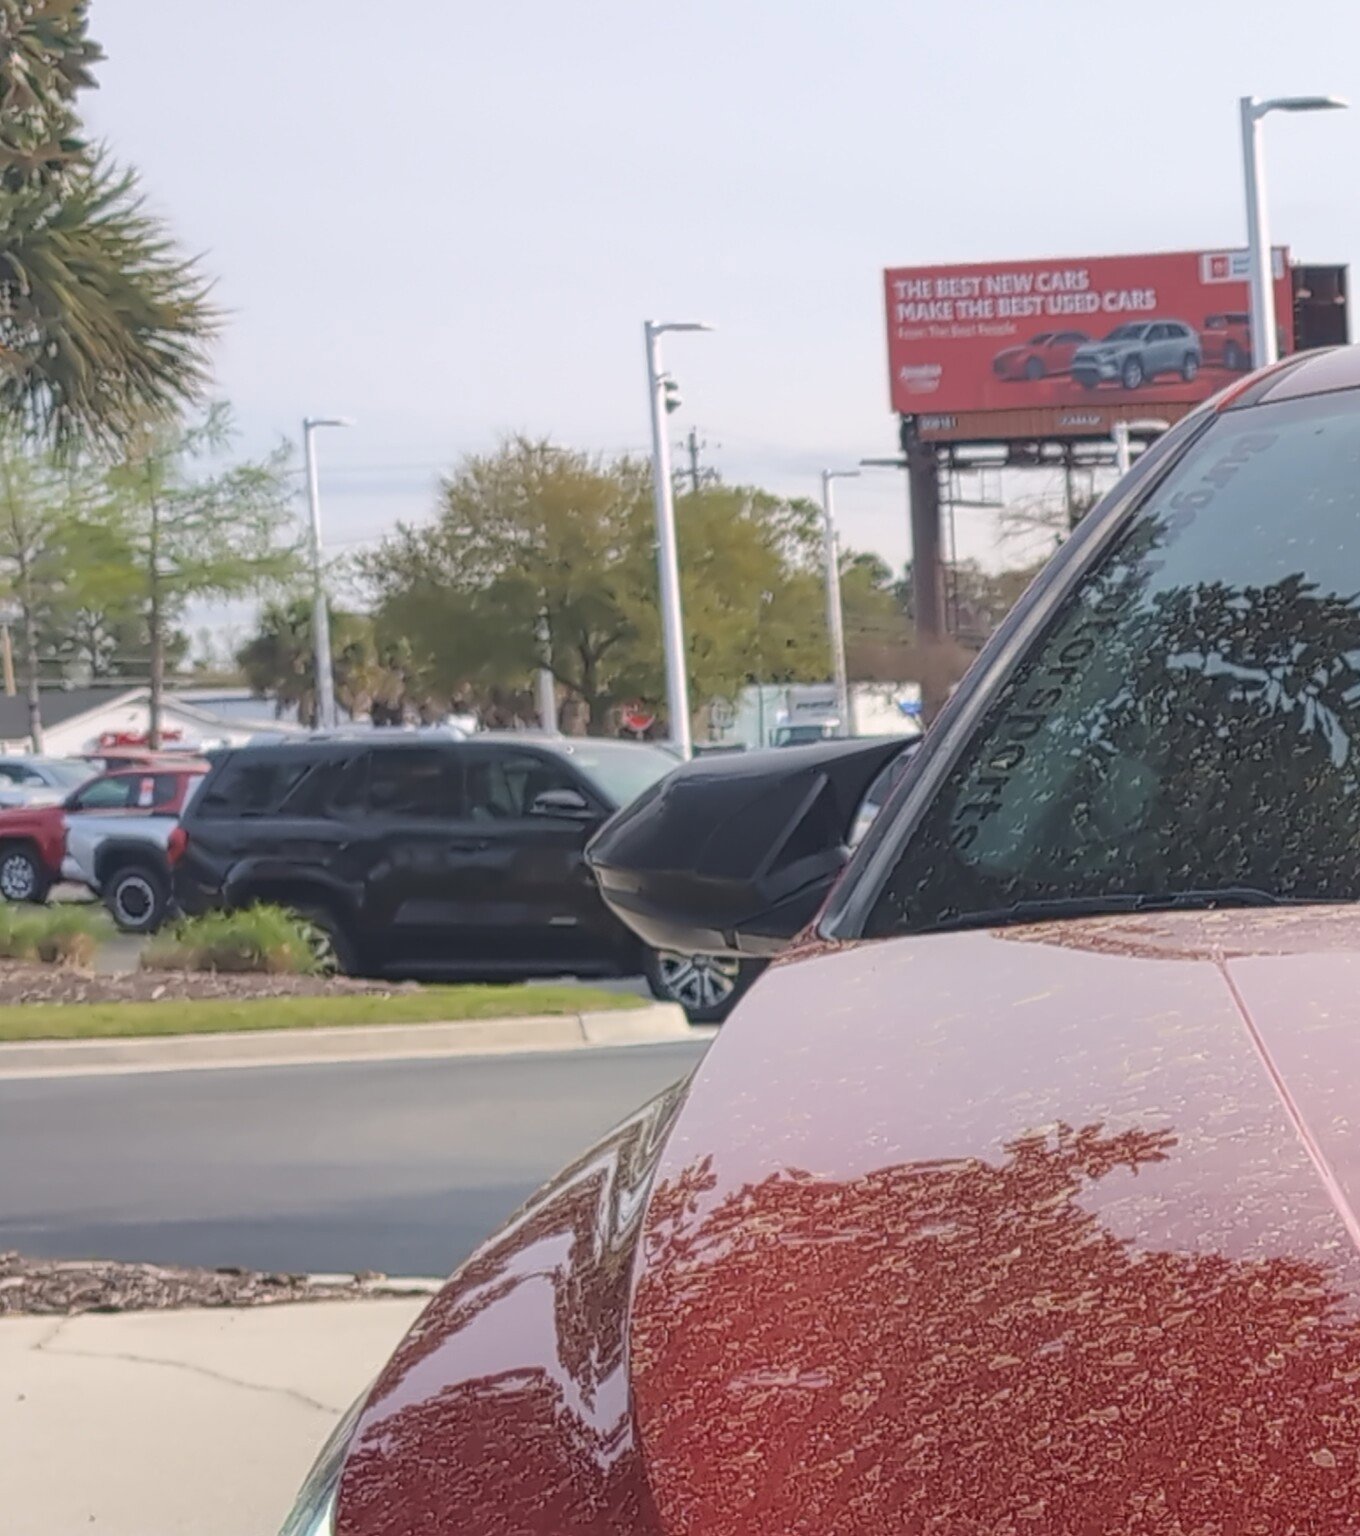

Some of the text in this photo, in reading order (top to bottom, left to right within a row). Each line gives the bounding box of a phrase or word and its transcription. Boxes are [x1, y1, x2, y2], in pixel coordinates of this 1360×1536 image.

[894, 269, 1090, 299] THE BEST NEW CARS
[897, 288, 1157, 322] MAKE THE BEST USED CARS
